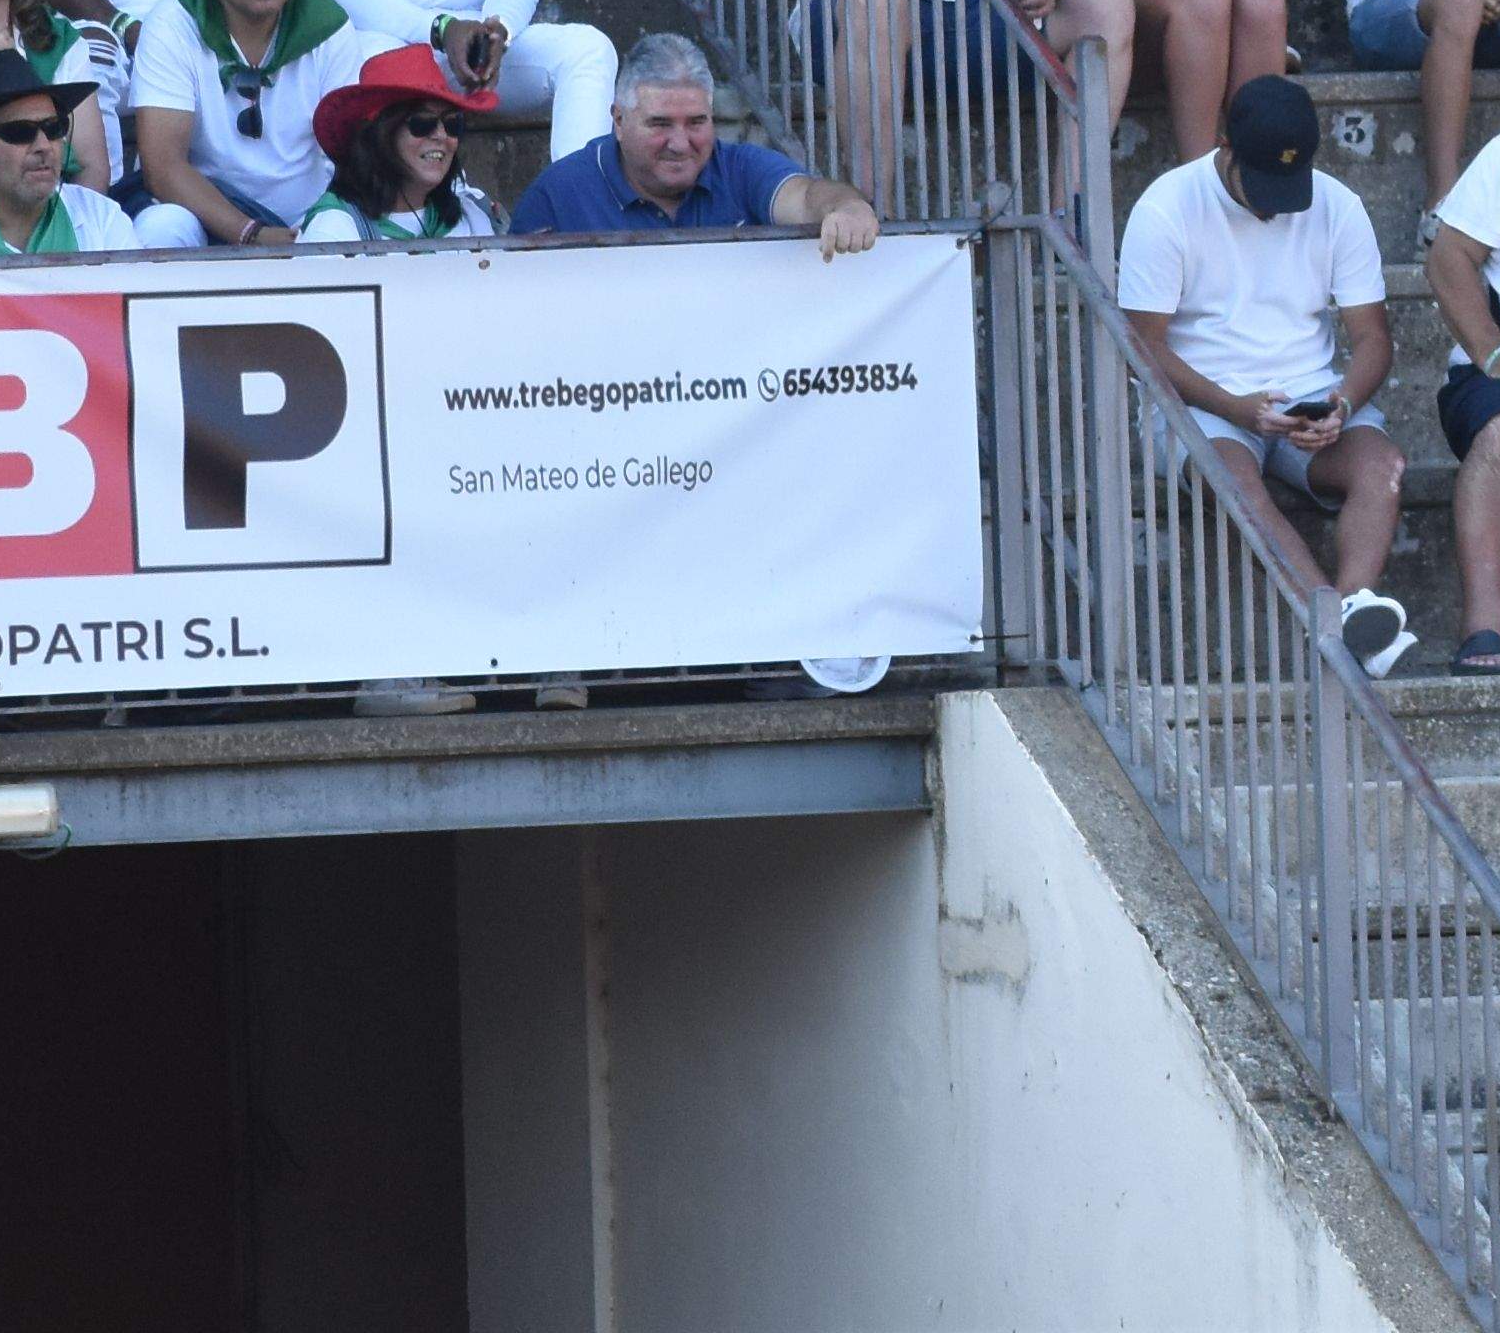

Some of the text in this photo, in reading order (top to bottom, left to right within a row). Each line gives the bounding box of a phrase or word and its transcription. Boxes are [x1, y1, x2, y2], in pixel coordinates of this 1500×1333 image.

[443, 362, 918, 413] www.trebegopatri.com 654393834
[448, 455, 714, 495] San Mateo de Gallego
[183, 616, 271, 661] S.L.
